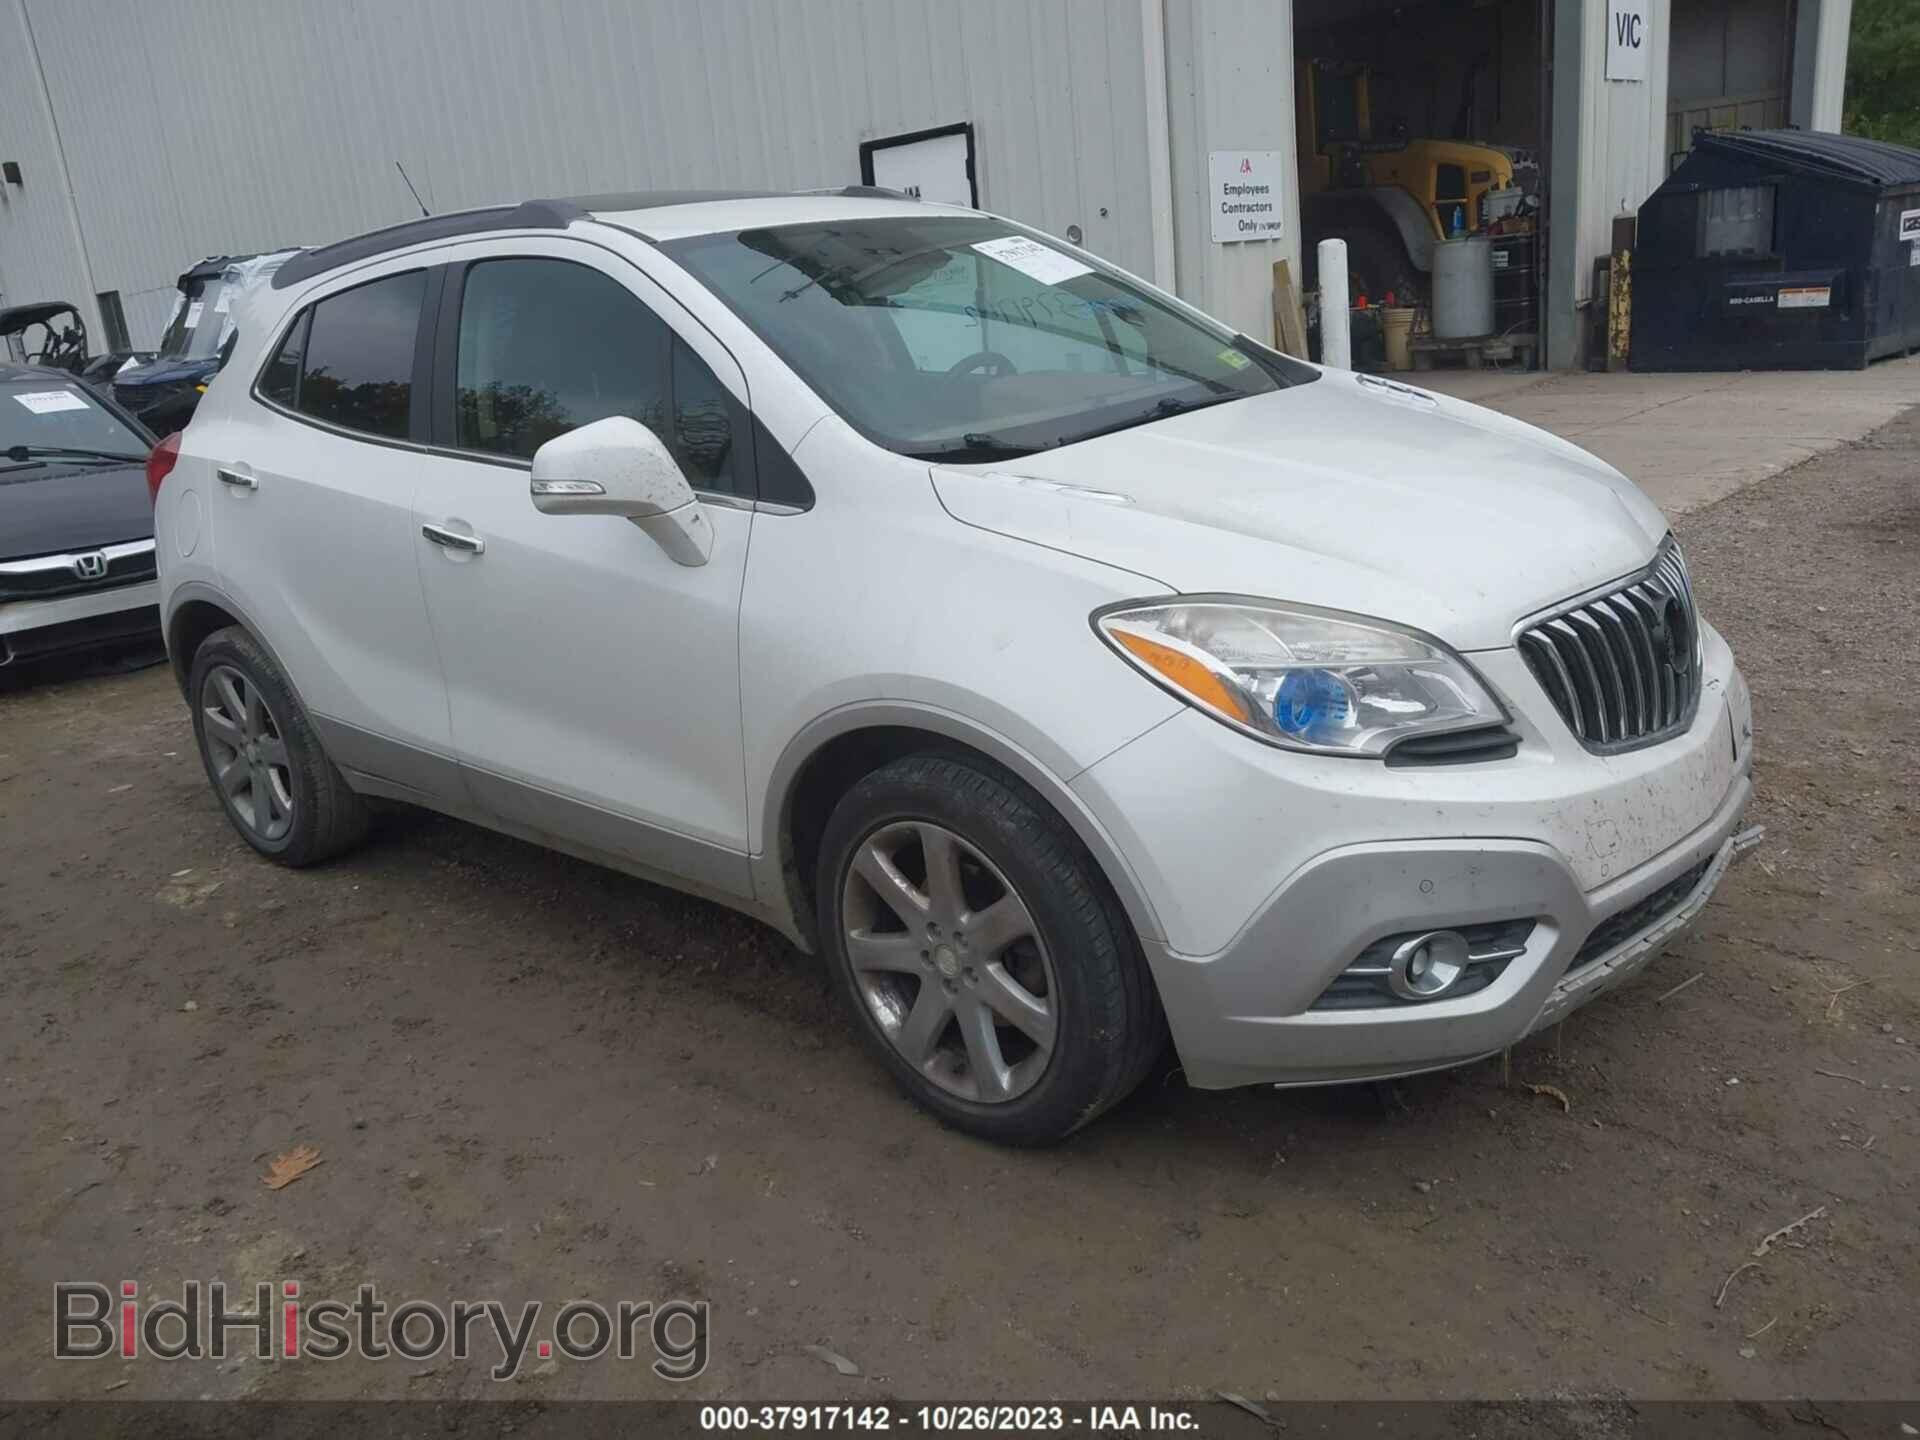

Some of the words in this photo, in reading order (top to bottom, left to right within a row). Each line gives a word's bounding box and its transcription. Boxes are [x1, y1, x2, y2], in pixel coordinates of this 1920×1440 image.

[1616, 12, 1641, 48] VIC
[1223, 182, 1270, 197] Employees
[1221, 201, 1273, 214] Contractors
[1238, 218, 1258, 233] Only
